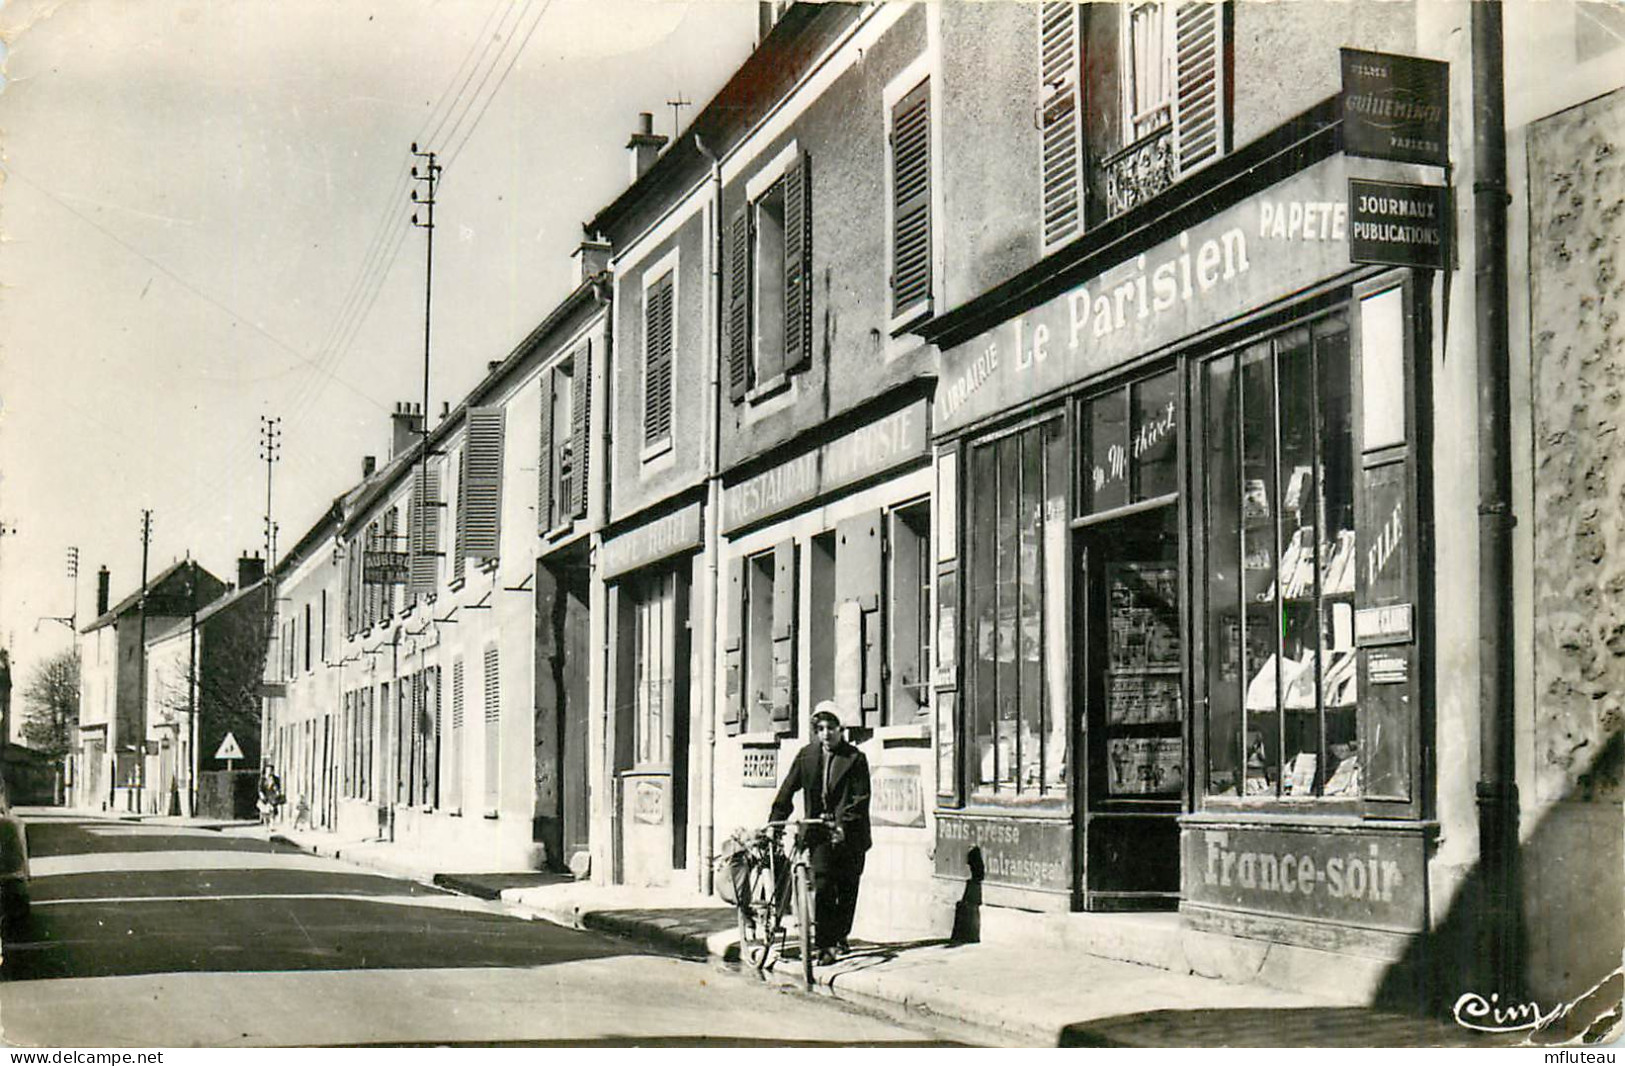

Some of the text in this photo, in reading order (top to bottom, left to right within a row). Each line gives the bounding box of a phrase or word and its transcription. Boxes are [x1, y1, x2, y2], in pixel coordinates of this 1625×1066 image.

[1358, 196, 1436, 218] JOURNAUX
[1353, 221, 1440, 246] PUBLICATIONS
[941, 343, 998, 422] LIBRAIRIE
[1013, 318, 1049, 372] Le
[1067, 226, 1251, 350] Parisien
[743, 754, 775, 778] BERGER
[1204, 830, 1402, 902] France-soir
